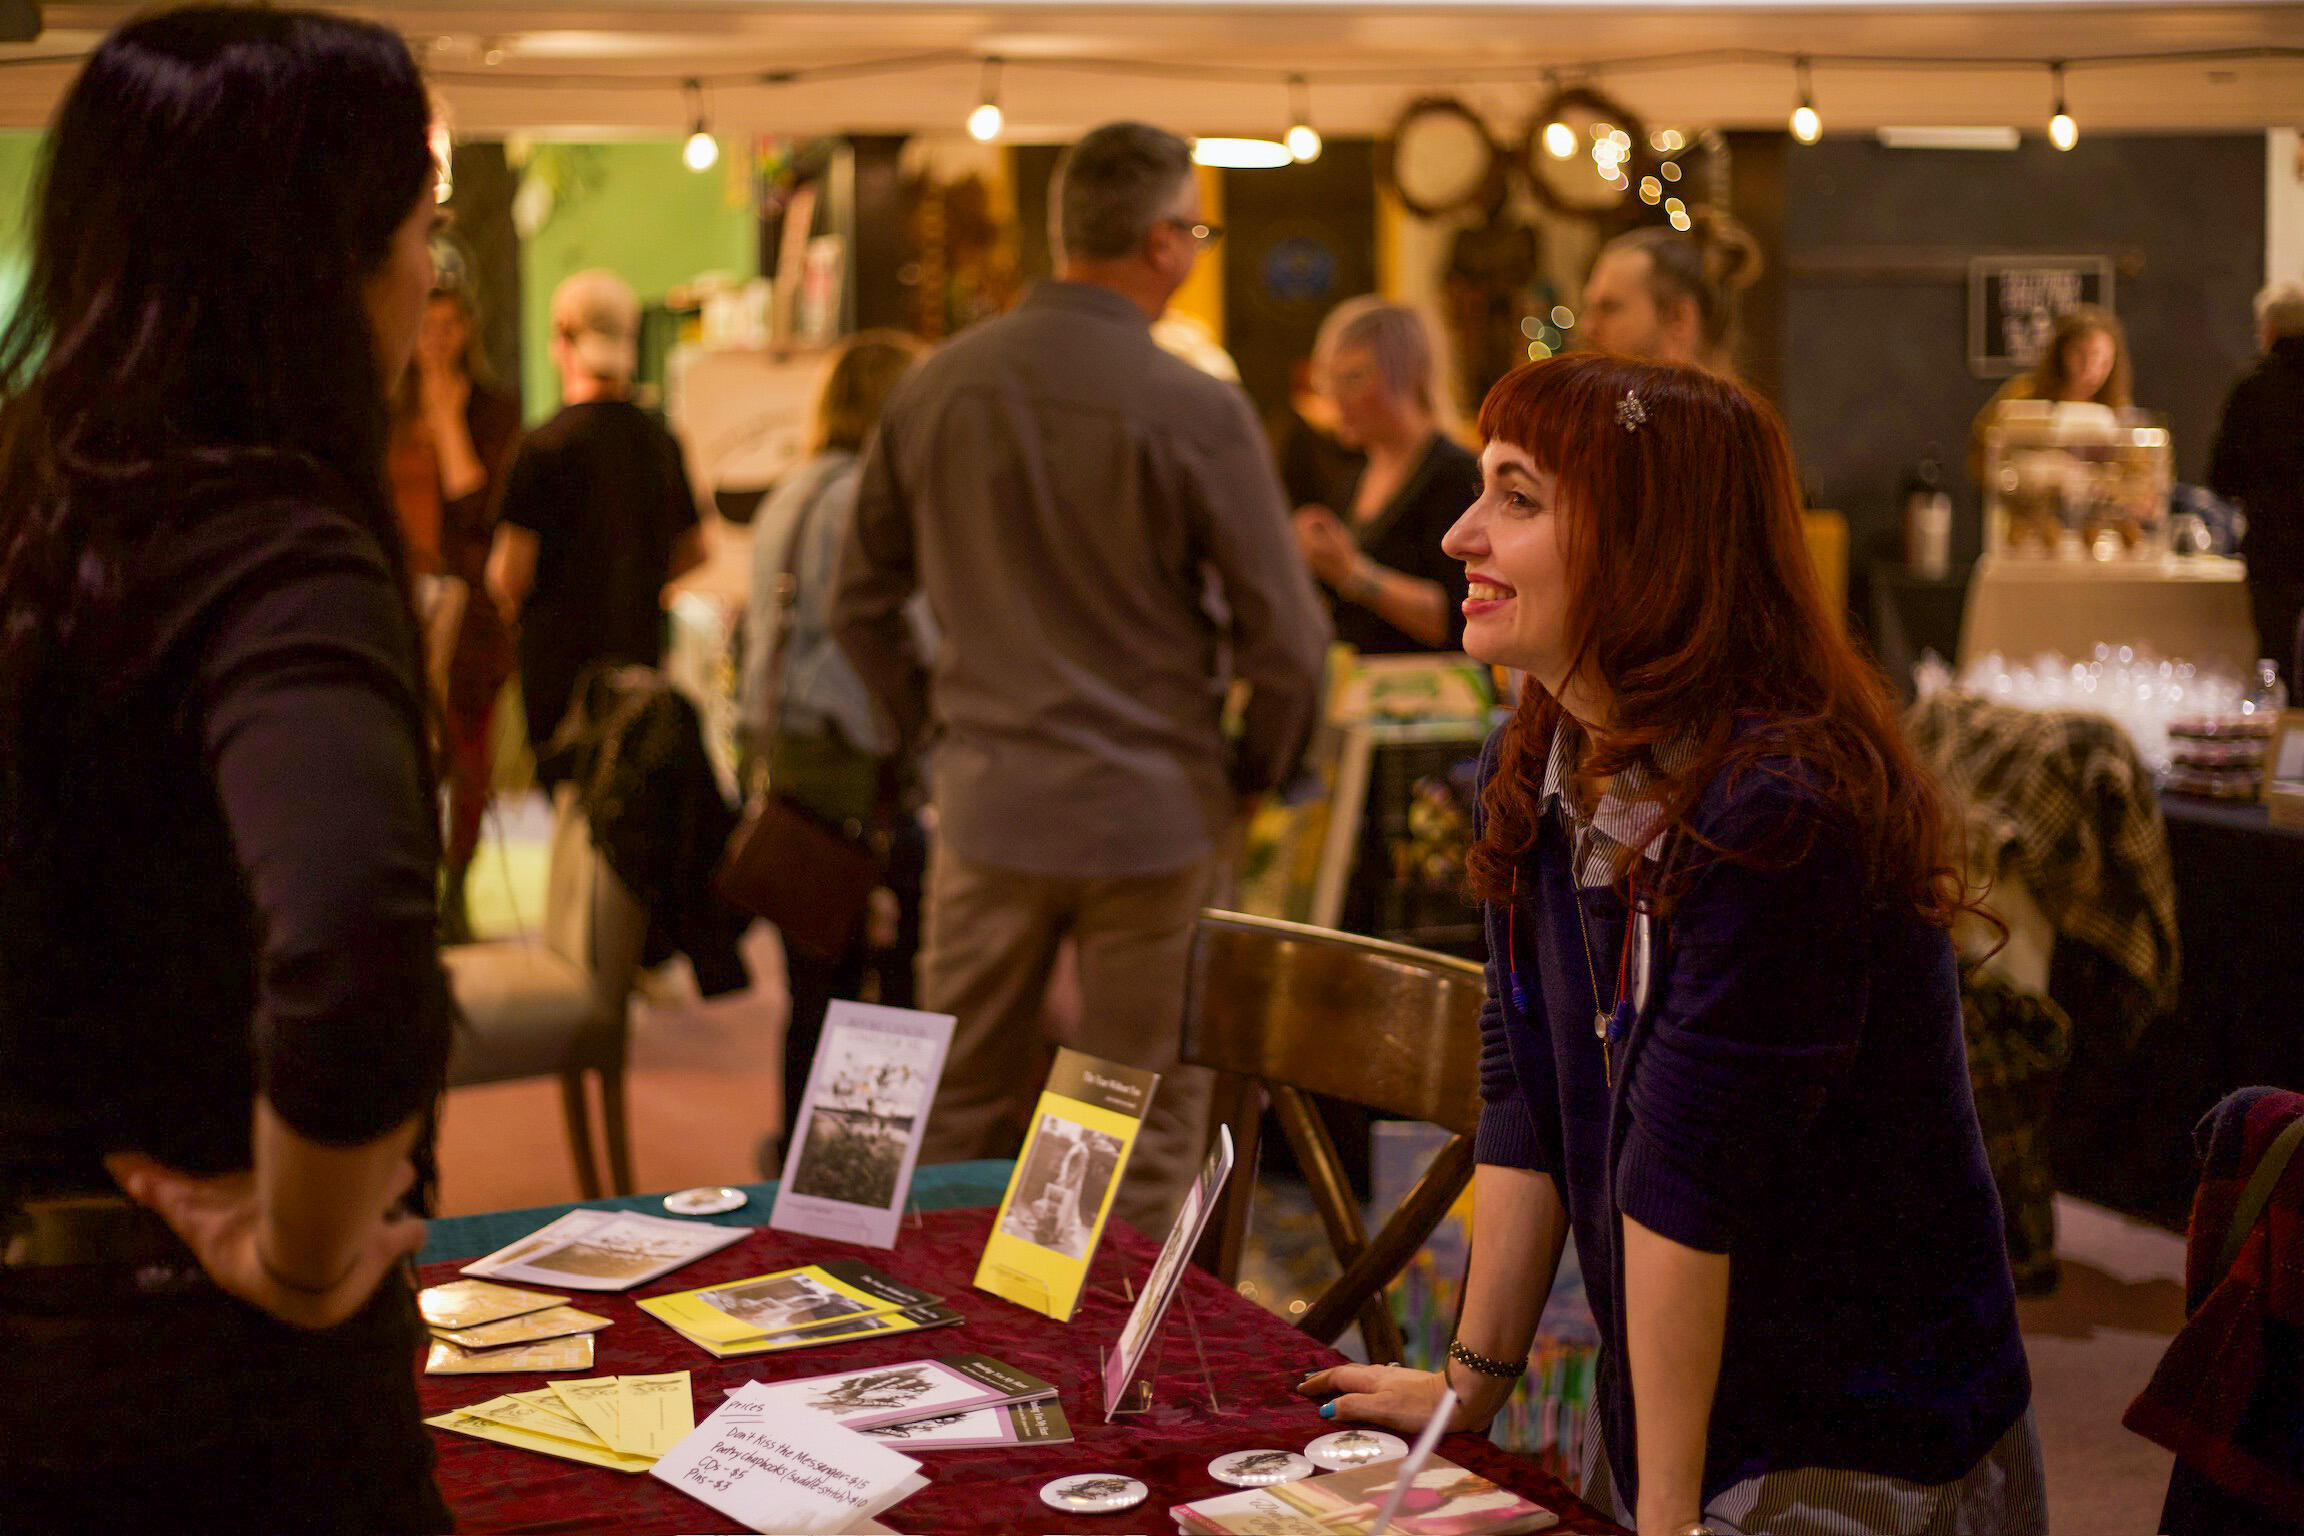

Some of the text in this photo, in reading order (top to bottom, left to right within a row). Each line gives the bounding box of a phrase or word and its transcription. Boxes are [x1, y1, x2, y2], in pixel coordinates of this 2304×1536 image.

[725, 1400, 765, 1412] prices
[726, 1427, 757, 1441] Don't
[753, 1434, 777, 1449] Kiss
[774, 1443, 794, 1458] the
[698, 1456, 721, 1472] CDs
[683, 1468, 708, 1484] Pins
